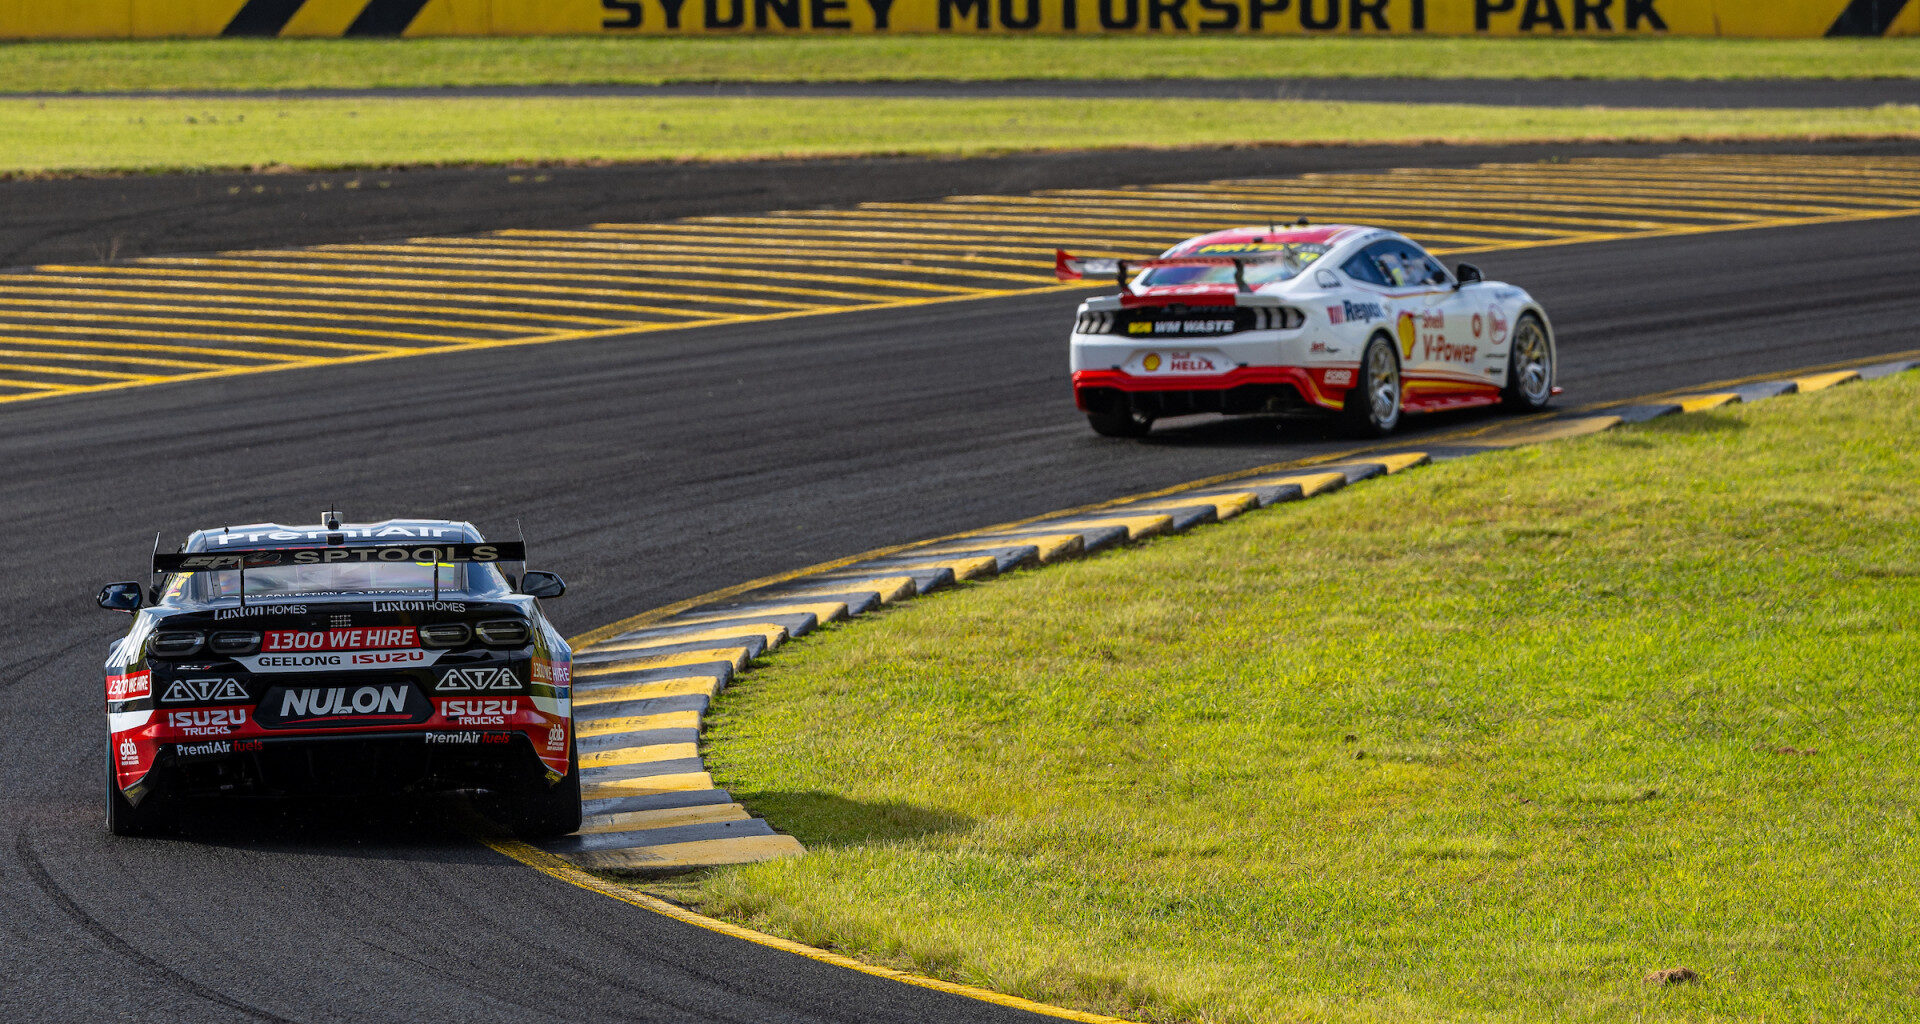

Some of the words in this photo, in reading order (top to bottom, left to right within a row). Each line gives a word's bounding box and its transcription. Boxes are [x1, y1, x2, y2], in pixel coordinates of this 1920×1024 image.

[601, 0, 894, 28] SYDNEY
[938, 0, 1426, 30] MOTORSPORT
[1475, 0, 1669, 31] PARK
[1154, 320, 1182, 334] WM
[1183, 319, 1235, 333] WASTE
[1423, 309, 1445, 329] Shell
[1423, 333, 1477, 363] V-Power
[1170, 359, 1216, 371] HELIX
[214, 606, 263, 621] Luxton
[266, 604, 307, 615] HOMES
[372, 600, 425, 612] Luxton
[427, 601, 466, 612] HOMES
[269, 632, 324, 650] 1300
[329, 630, 362, 647] WE
[366, 629, 415, 646] HIRE
[258, 655, 341, 667] GEELONG
[352, 651, 424, 664] ISUZU
[552, 667, 570, 681] HIRE
[108, 678, 129, 695] 1300
[280, 685, 409, 716] NULON
[441, 700, 517, 716] ISUZU
[168, 709, 246, 727] ISUZU
[458, 715, 504, 725] TRUCKS
[183, 726, 231, 736] TRUCKS
[425, 731, 480, 744] PremiAir
[482, 731, 510, 744] fuels
[176, 740, 231, 756] PremiAir
[234, 739, 263, 752] fuels
